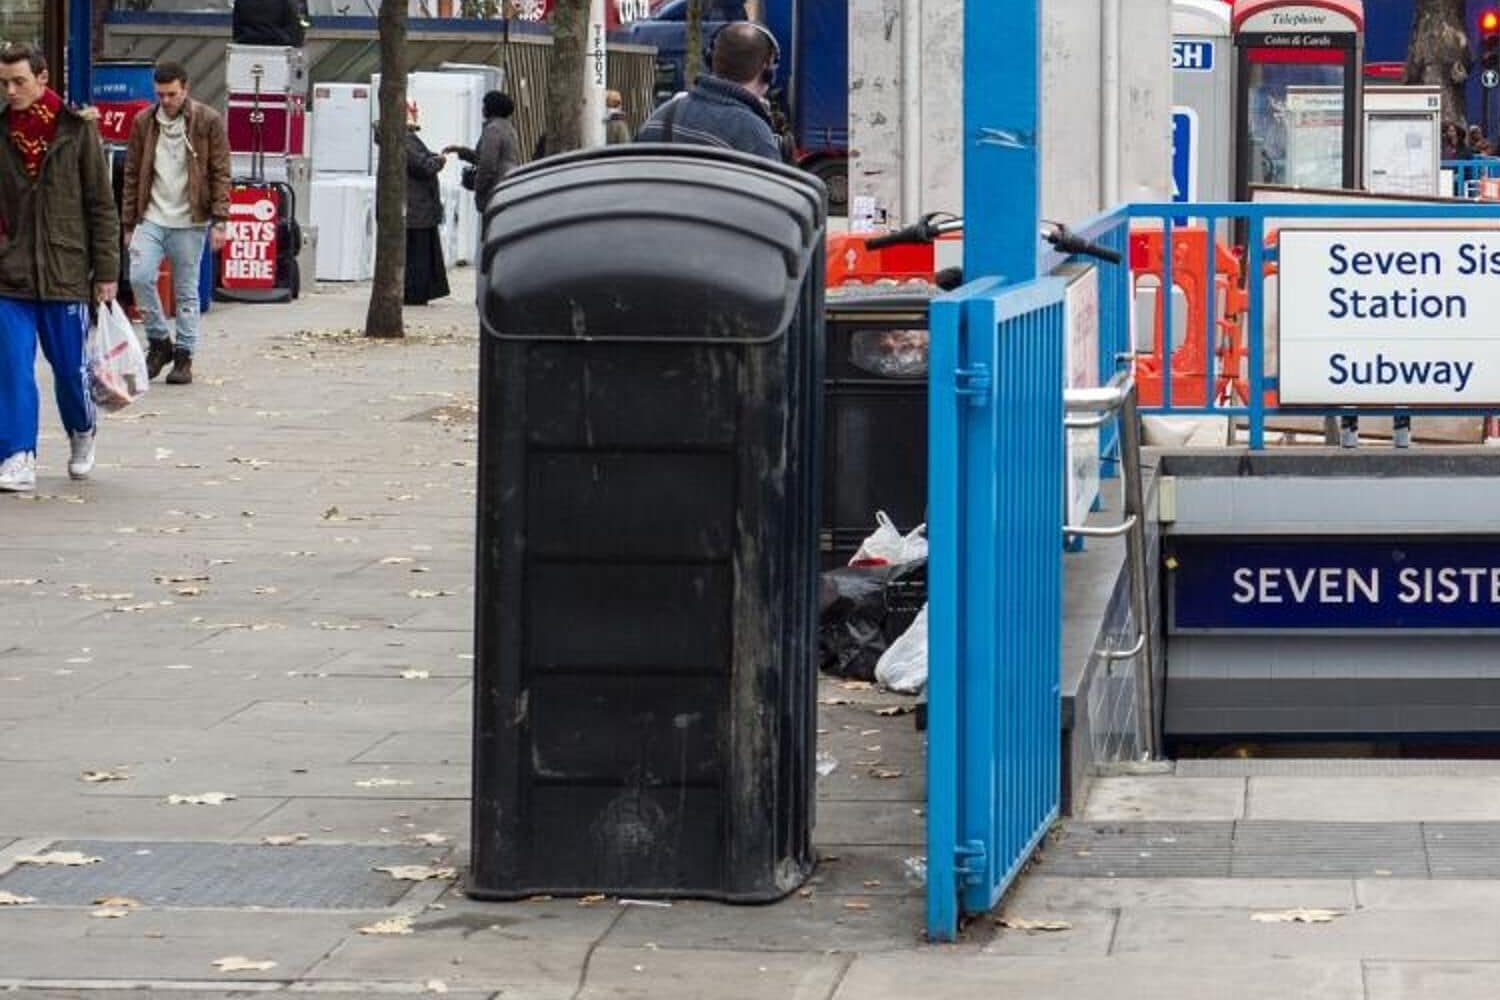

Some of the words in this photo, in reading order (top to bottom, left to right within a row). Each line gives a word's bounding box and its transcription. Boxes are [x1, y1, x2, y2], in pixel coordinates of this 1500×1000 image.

[1271, 12, 1327, 27] Telephone
[1263, 35, 1291, 46] Coins
[1303, 35, 1331, 46] Cards
[1172, 44, 1203, 68] SH
[226, 221, 276, 242] KEYS
[231, 242, 270, 260] CUT
[1328, 243, 1442, 276] Seven
[225, 260, 273, 280] HERE
[1328, 286, 1467, 319] Station
[1328, 353, 1474, 392] Subway
[1231, 566, 1381, 604] SEVEN
